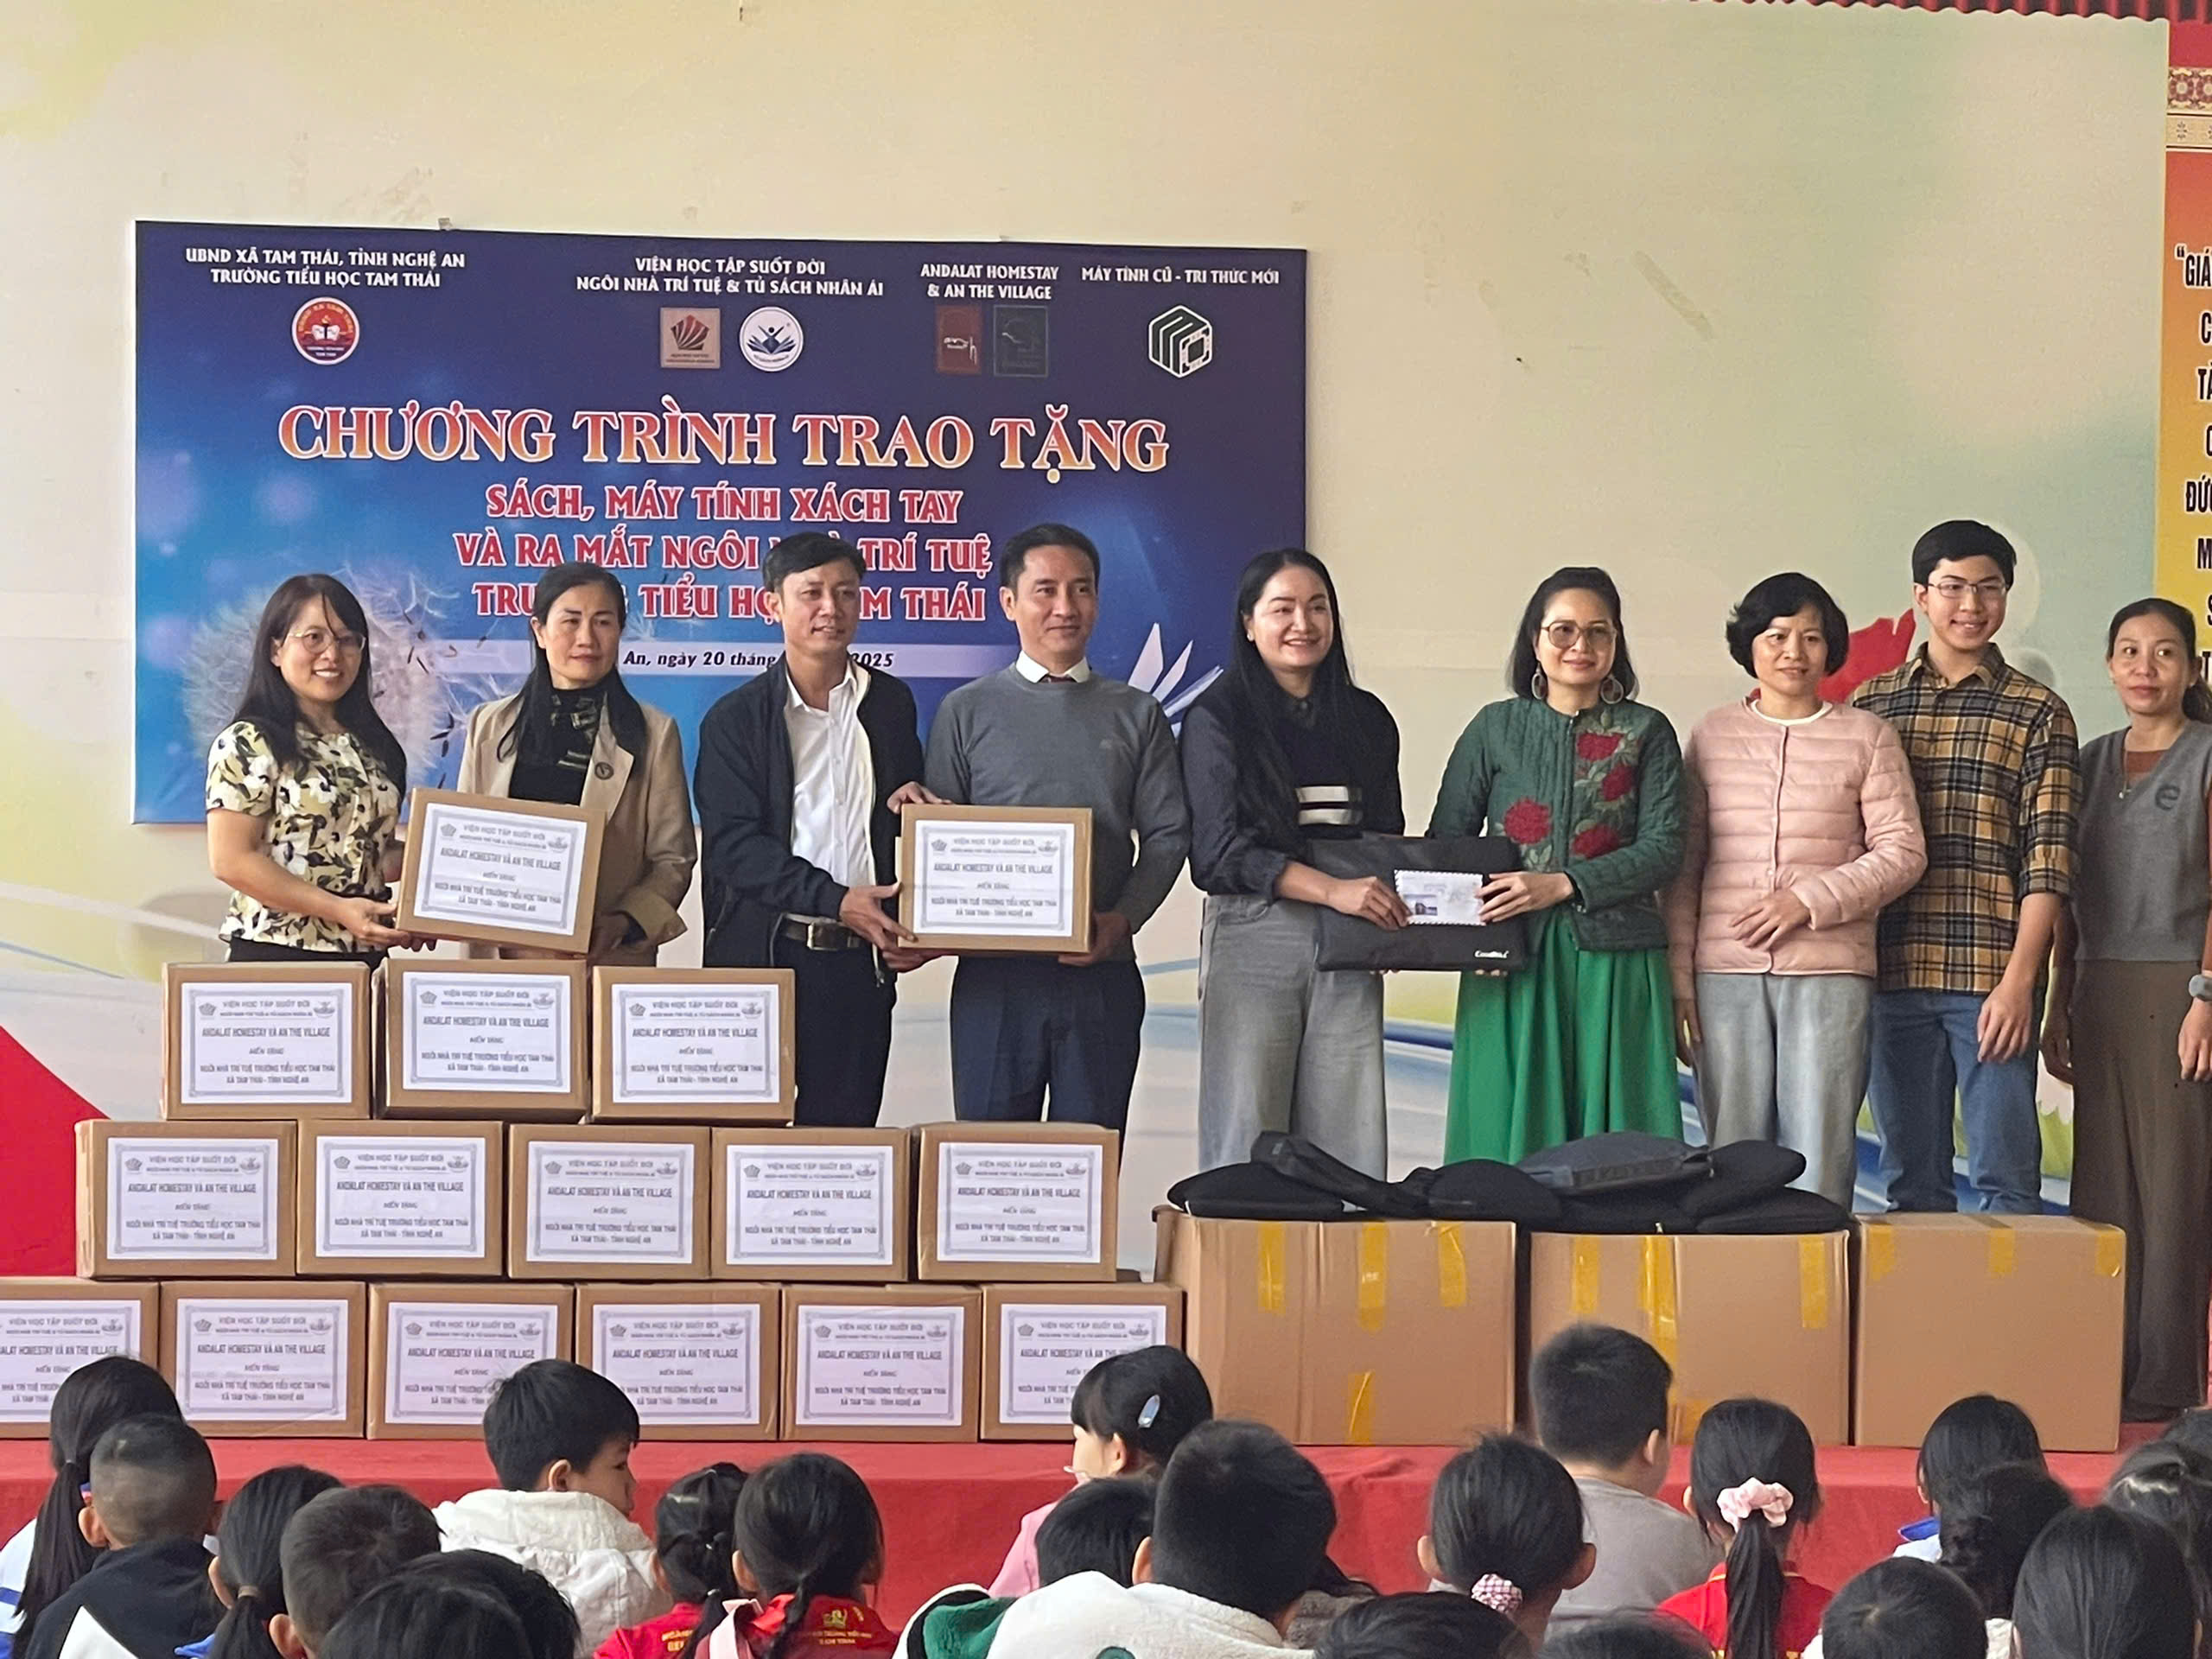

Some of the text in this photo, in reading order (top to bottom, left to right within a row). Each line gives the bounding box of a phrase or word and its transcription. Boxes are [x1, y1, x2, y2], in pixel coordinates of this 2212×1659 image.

[186, 246, 466, 270] UBND XÃ TAM THÁI, TỈNH NGHỆ AN
[635, 256, 826, 276] VIỆN HỌC TẬP SUỐT ĐỜI
[210, 264, 442, 289] TRƯỜNG TIỂU HỌC TAM THÁI
[919, 264, 1059, 282] ANDALAT HOMESTAY
[1081, 265, 1112, 282] MÁY
[1152, 266, 1173, 283] CŨ
[1185, 269, 1207, 283] TRI
[1251, 269, 1280, 284] MỚI
[576, 275, 885, 296] NGÔI NHÀ TRÍ TUỆ & TỦ SÁCH NHÂN ÁI
[926, 283, 1052, 300] & AN THE VILLAGE
[278, 394, 1170, 485] CHƯƠNG TRÌNH TRAO TẶNG
[486, 478, 963, 524] SÁCH, MÁY TÍNH XÁCH TAY
[453, 523, 994, 579] VÀ RA MẮT NGÔI TRÍ TUỆ
[639, 573, 719, 619] TIỂU
[902, 582, 987, 620] THÁI
[623, 652, 652, 668] An,
[658, 652, 697, 669] ngày
[702, 652, 725, 666] 20
[730, 652, 776, 669] tháng
[512, 855, 521, 866] AN
[523, 856, 535, 868] THE
[536, 858, 562, 870] VILLAGE
[1004, 863, 1014, 873] AN
[1015, 863, 1027, 874] THE
[1028, 864, 1053, 874] VILLAGE
[278, 1027, 288, 1037] AN
[289, 1027, 302, 1037] THE
[303, 1027, 330, 1037] VILLAGE
[707, 1027, 716, 1038] AN
[718, 1027, 730, 1038] THE
[732, 1027, 758, 1038] VILLAGE
[204, 1183, 213, 1192] AN
[215, 1183, 227, 1192] THE
[229, 1183, 256, 1192] VILLAGE
[411, 1181, 421, 1192] AN
[423, 1181, 435, 1192] THE
[436, 1181, 463, 1192] VILLAGE
[821, 1190, 830, 1199] AN
[832, 1190, 843, 1199] THE
[845, 1190, 871, 1199] VILLAGE
[1031, 1187, 1040, 1197] AN
[1042, 1187, 1053, 1198] THE
[1055, 1187, 1081, 1198] VILLAGE
[273, 1344, 283, 1353] AN
[284, 1344, 296, 1354] THE
[298, 1344, 325, 1354] VILLAGE
[891, 1350, 900, 1359] AN
[902, 1350, 914, 1359] THE
[916, 1350, 942, 1360] VILLAGE
